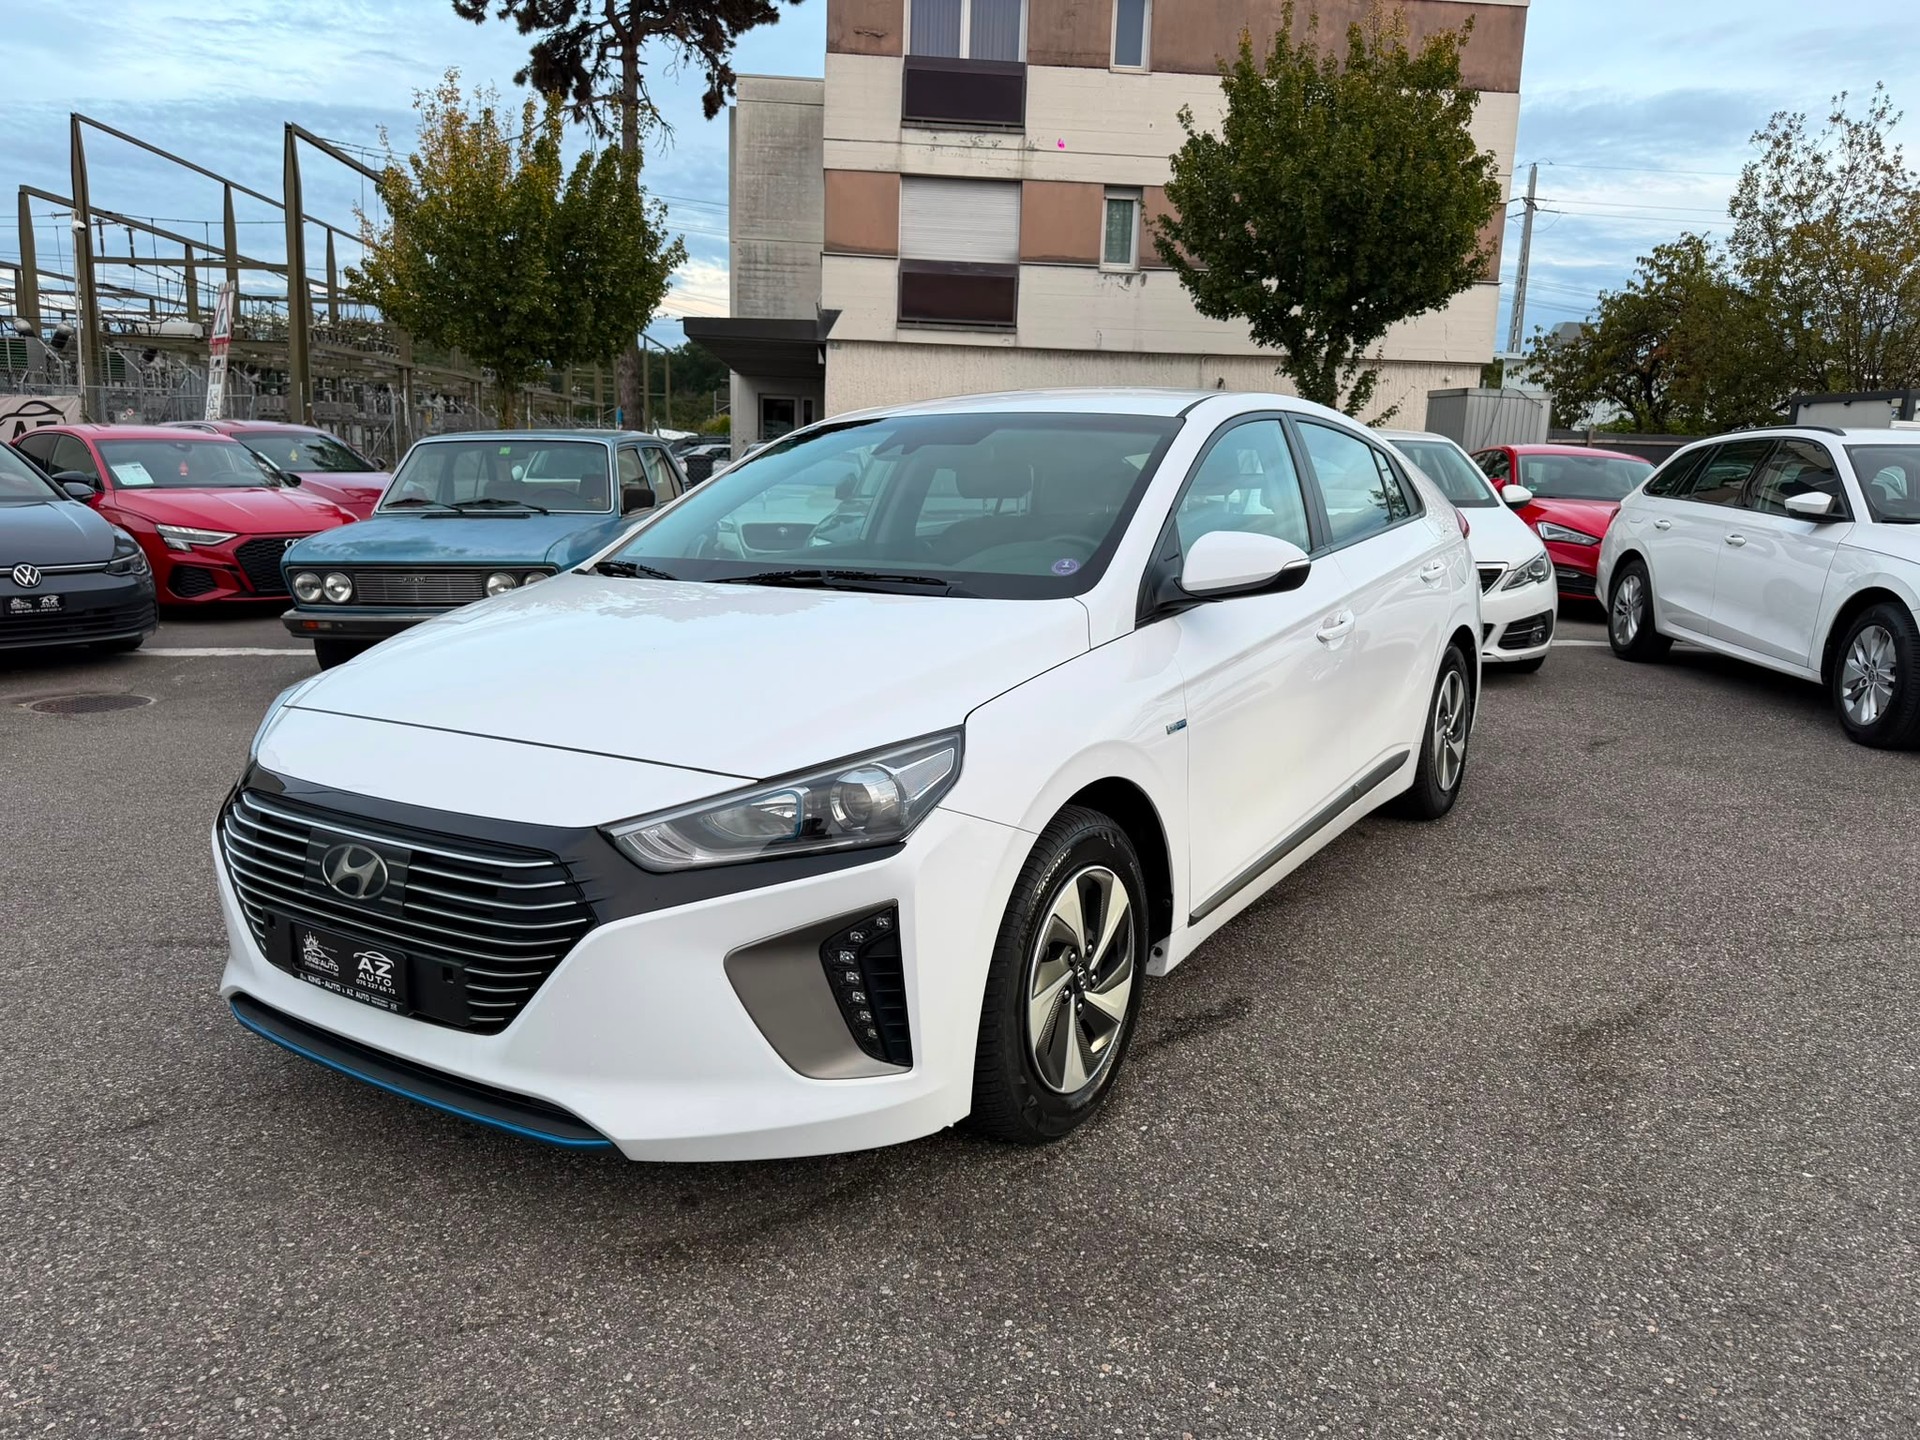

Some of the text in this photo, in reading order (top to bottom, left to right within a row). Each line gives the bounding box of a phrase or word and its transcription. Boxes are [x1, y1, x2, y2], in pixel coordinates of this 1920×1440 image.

[12, 421, 57, 440] A
[358, 957, 392, 979] AZ
[358, 972, 392, 987] AUTO
